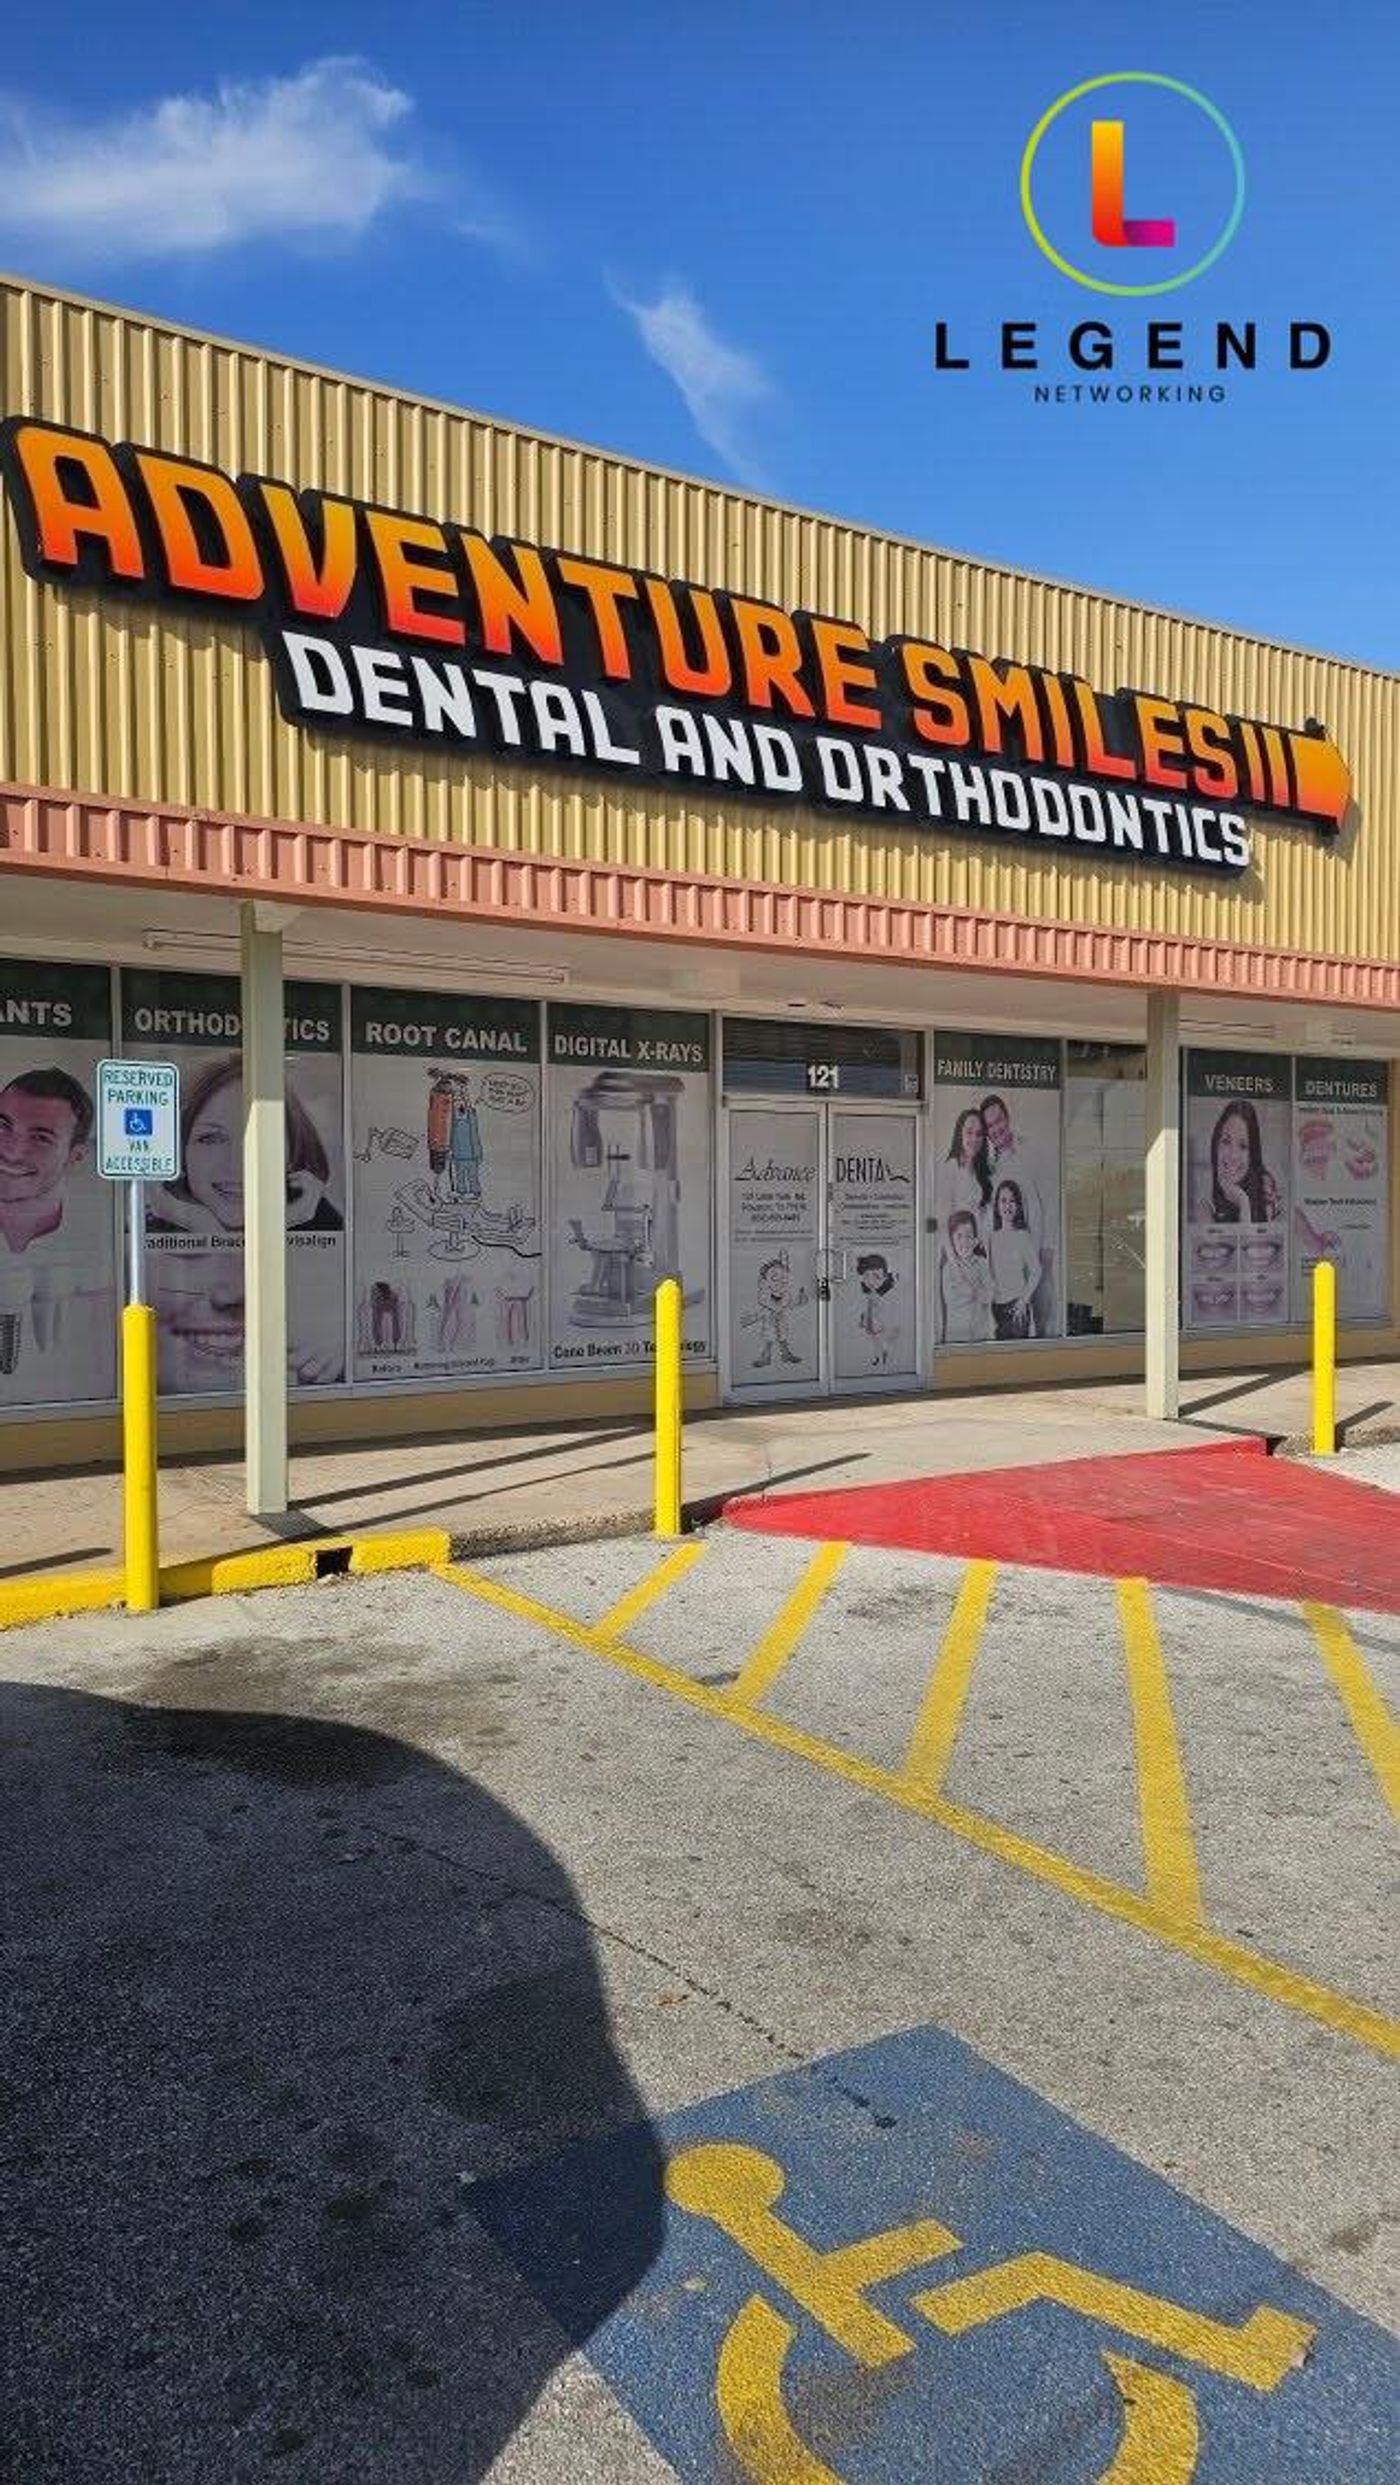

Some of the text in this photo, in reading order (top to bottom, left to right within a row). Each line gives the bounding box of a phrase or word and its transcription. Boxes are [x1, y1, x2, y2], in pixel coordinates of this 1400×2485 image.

[15, 425, 1239, 799] ADVENTURE SMILES
[281, 630, 1251, 867] DENTAL AND ORTHODONTICS
[134, 1007, 330, 1042] ORTHODICS
[365, 1021, 528, 1053] ROOT CANAL
[554, 1034, 703, 1064] DIGITAL X-RAYS
[104, 1069, 173, 1087] RESERVED
[807, 1064, 839, 1090] 121
[937, 1059, 1057, 1082] FAMILY DENTISTRY
[1204, 1073, 1275, 1093] VENEERS
[1305, 1080, 1378, 1098] DENTURES
[108, 1088, 169, 1106] PARKING
[128, 1139, 150, 1153] VAN
[105, 1157, 173, 1173] ACCESSIBLE
